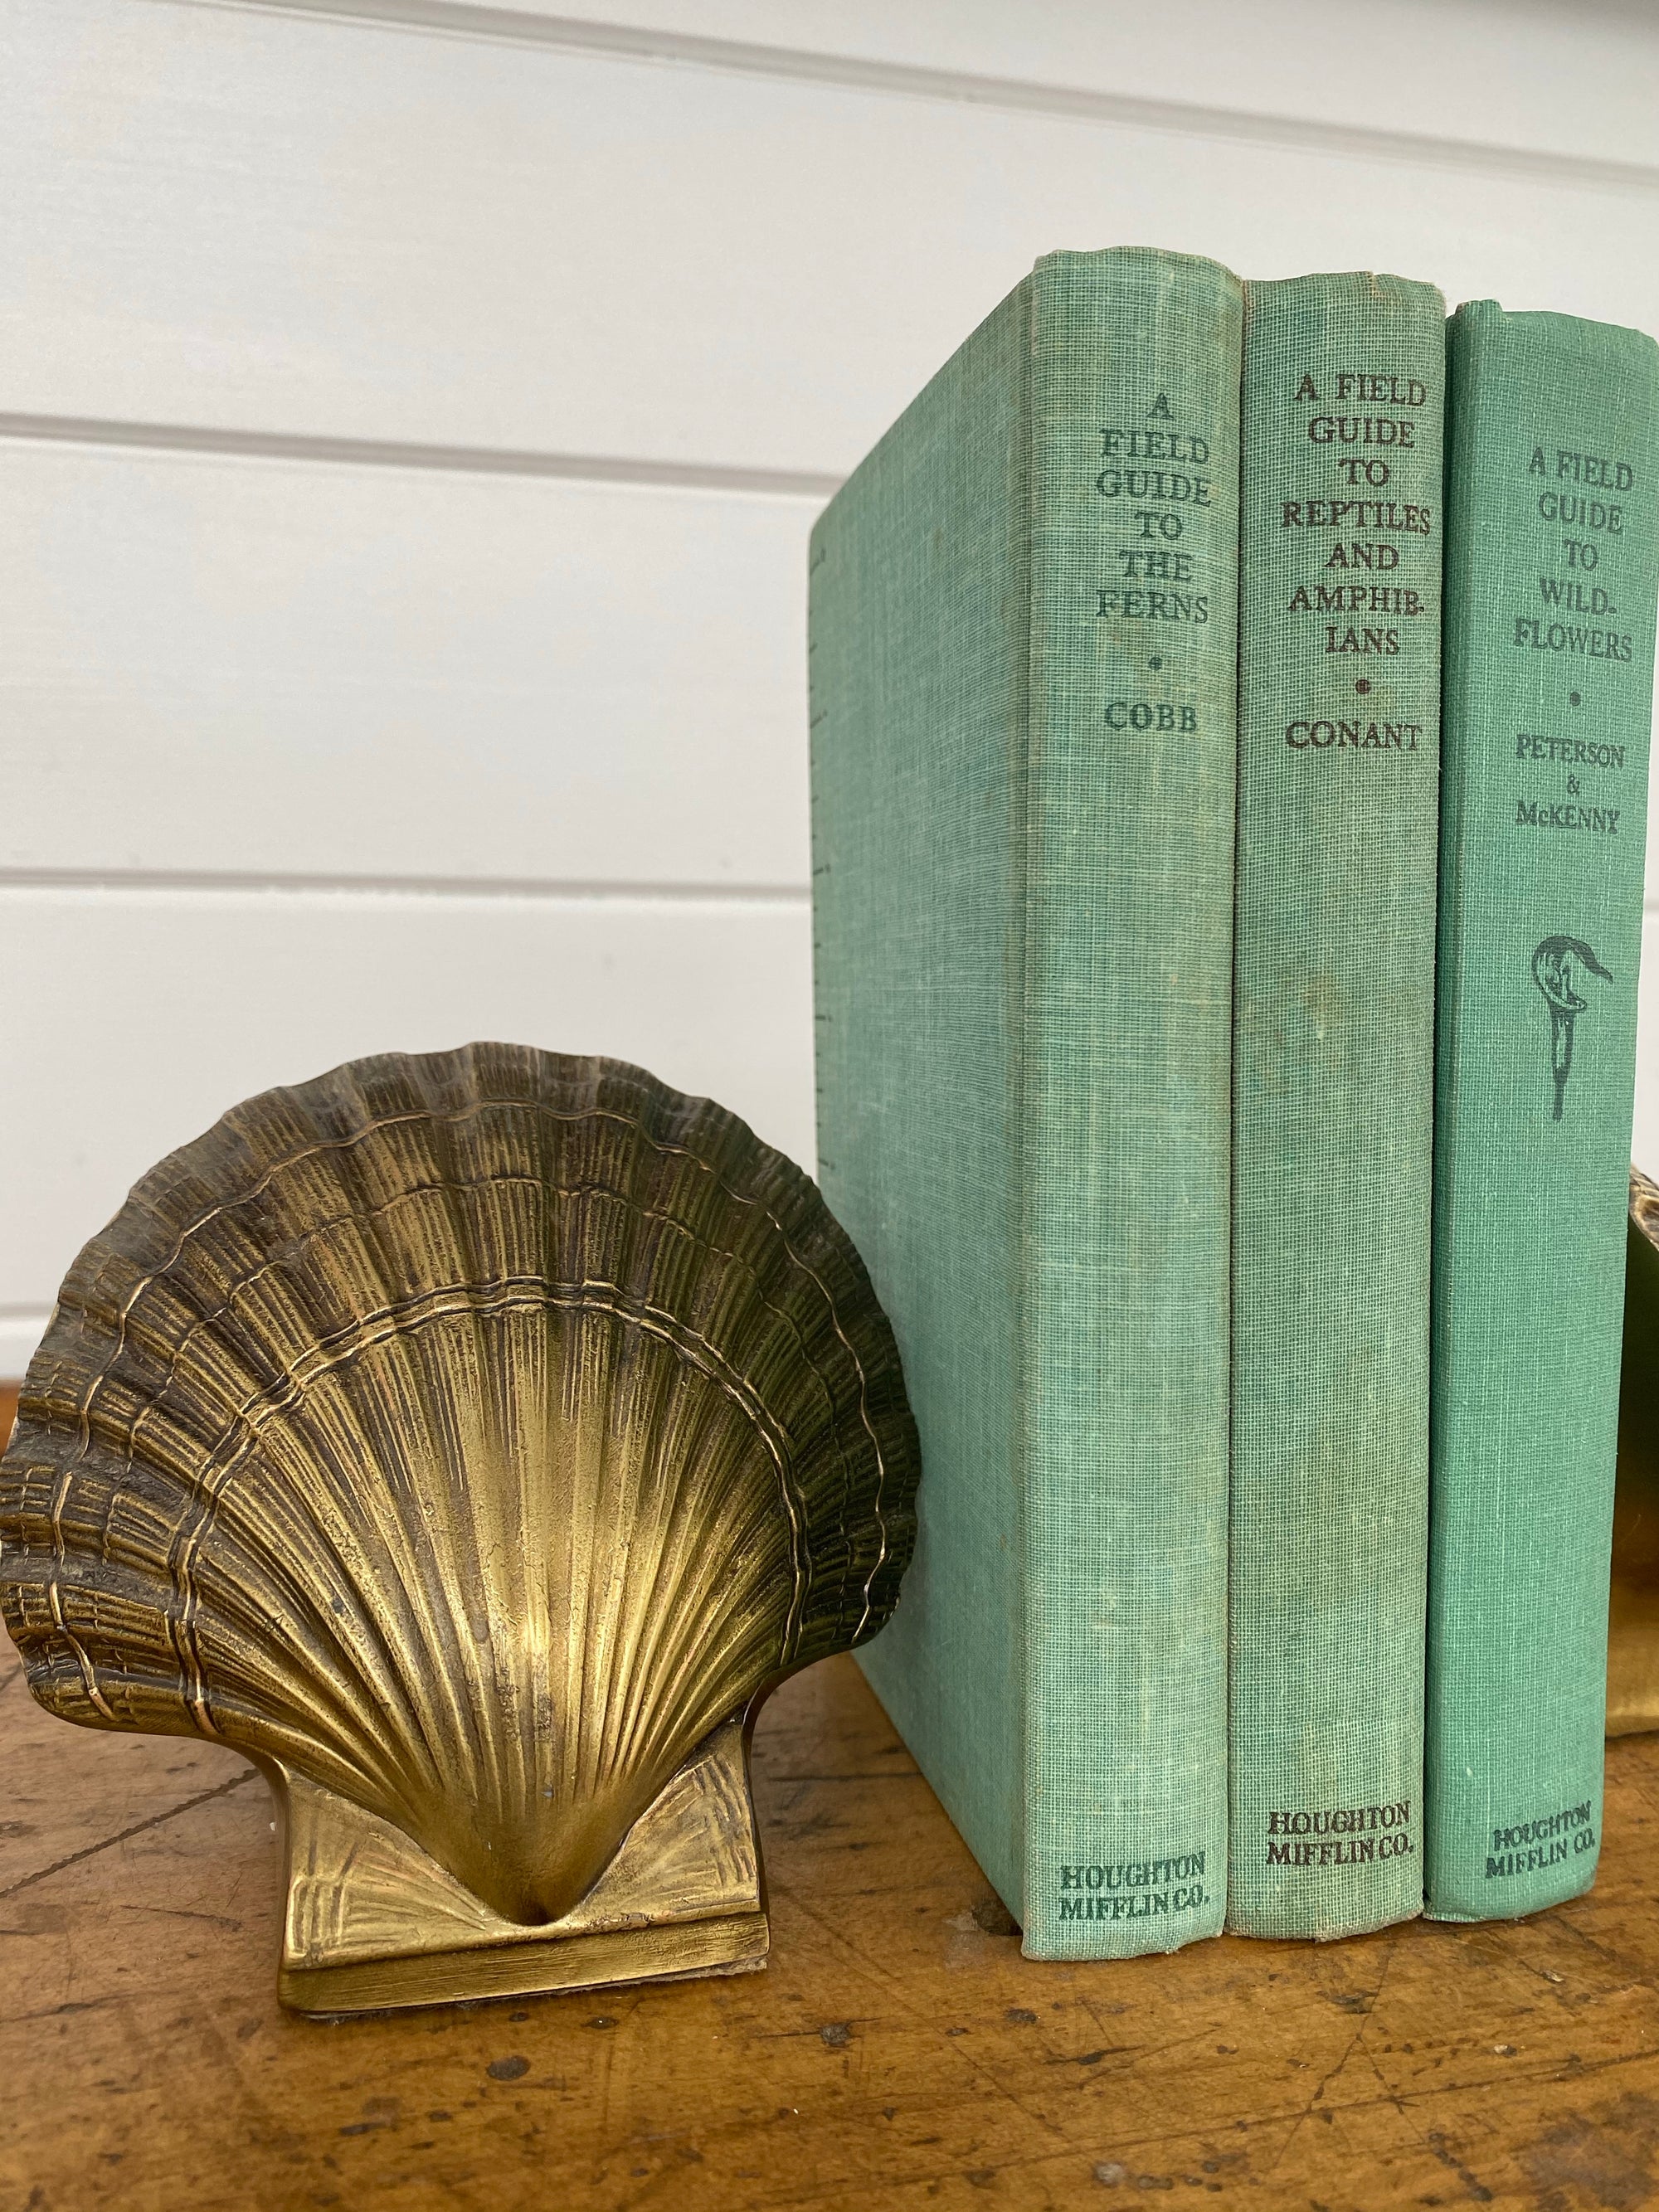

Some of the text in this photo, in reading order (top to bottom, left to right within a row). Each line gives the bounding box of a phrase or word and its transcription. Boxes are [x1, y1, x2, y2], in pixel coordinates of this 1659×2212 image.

[1147, 392, 1175, 421] A
[1293, 374, 1428, 407] A FIELD
[1099, 429, 1210, 464] FIELD
[1308, 416, 1416, 448] GUIDE
[1338, 459, 1390, 487] TO
[1529, 446, 1634, 491] A FIELD
[1096, 469, 1211, 508] GUIDE
[1134, 511, 1183, 540] TO
[1280, 501, 1432, 536] REPTILES
[1539, 491, 1623, 535] GUIDE
[1118, 550, 1194, 581] THE
[1326, 543, 1400, 571] AND
[1563, 538, 1598, 571] TO
[1096, 589, 1209, 624] FERNS
[1325, 626, 1399, 656] IANS
[1513, 618, 1633, 664] FLOWERS
[1104, 702, 1197, 732] COBB
[1284, 721, 1422, 751] CONANT
[1515, 734, 1625, 769] PETERSON
[1567, 773, 1580, 795] &
[1515, 801, 1621, 834] McKENNY
[1267, 1801, 1411, 1835] HOUGHTON
[1493, 1800, 1592, 1851] HOUGHTON
[1266, 1832, 1414, 1866] MIFFLIN CO.
[1485, 1828, 1596, 1879] MIFFLIN CO.
[1060, 1850, 1206, 1890] HOUGHTON
[1058, 1884, 1210, 1921] MIFFLIN CO.
